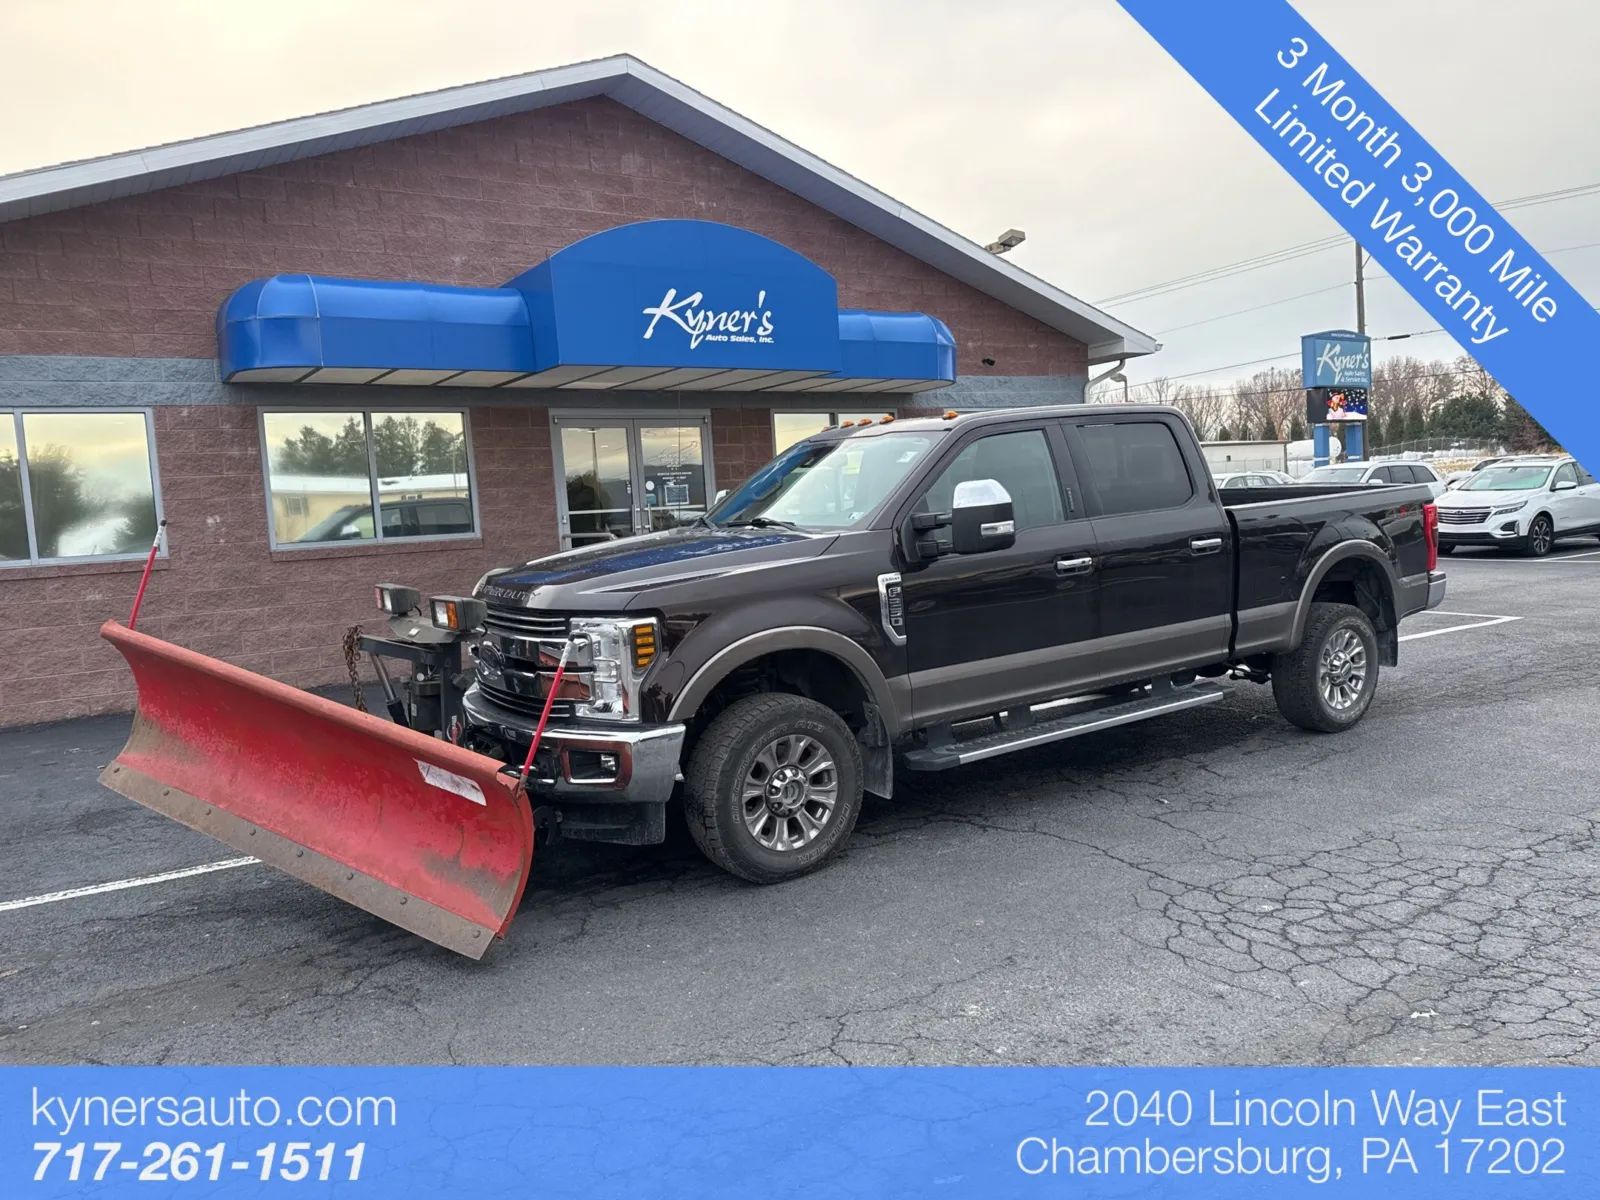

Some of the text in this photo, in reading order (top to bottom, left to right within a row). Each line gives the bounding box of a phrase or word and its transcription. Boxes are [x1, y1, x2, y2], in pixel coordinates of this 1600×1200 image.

[642, 288, 774, 350] Kyner's
[705, 334, 775, 344] Auto Sales, Inc.
[1316, 341, 1369, 384] Kyner's
